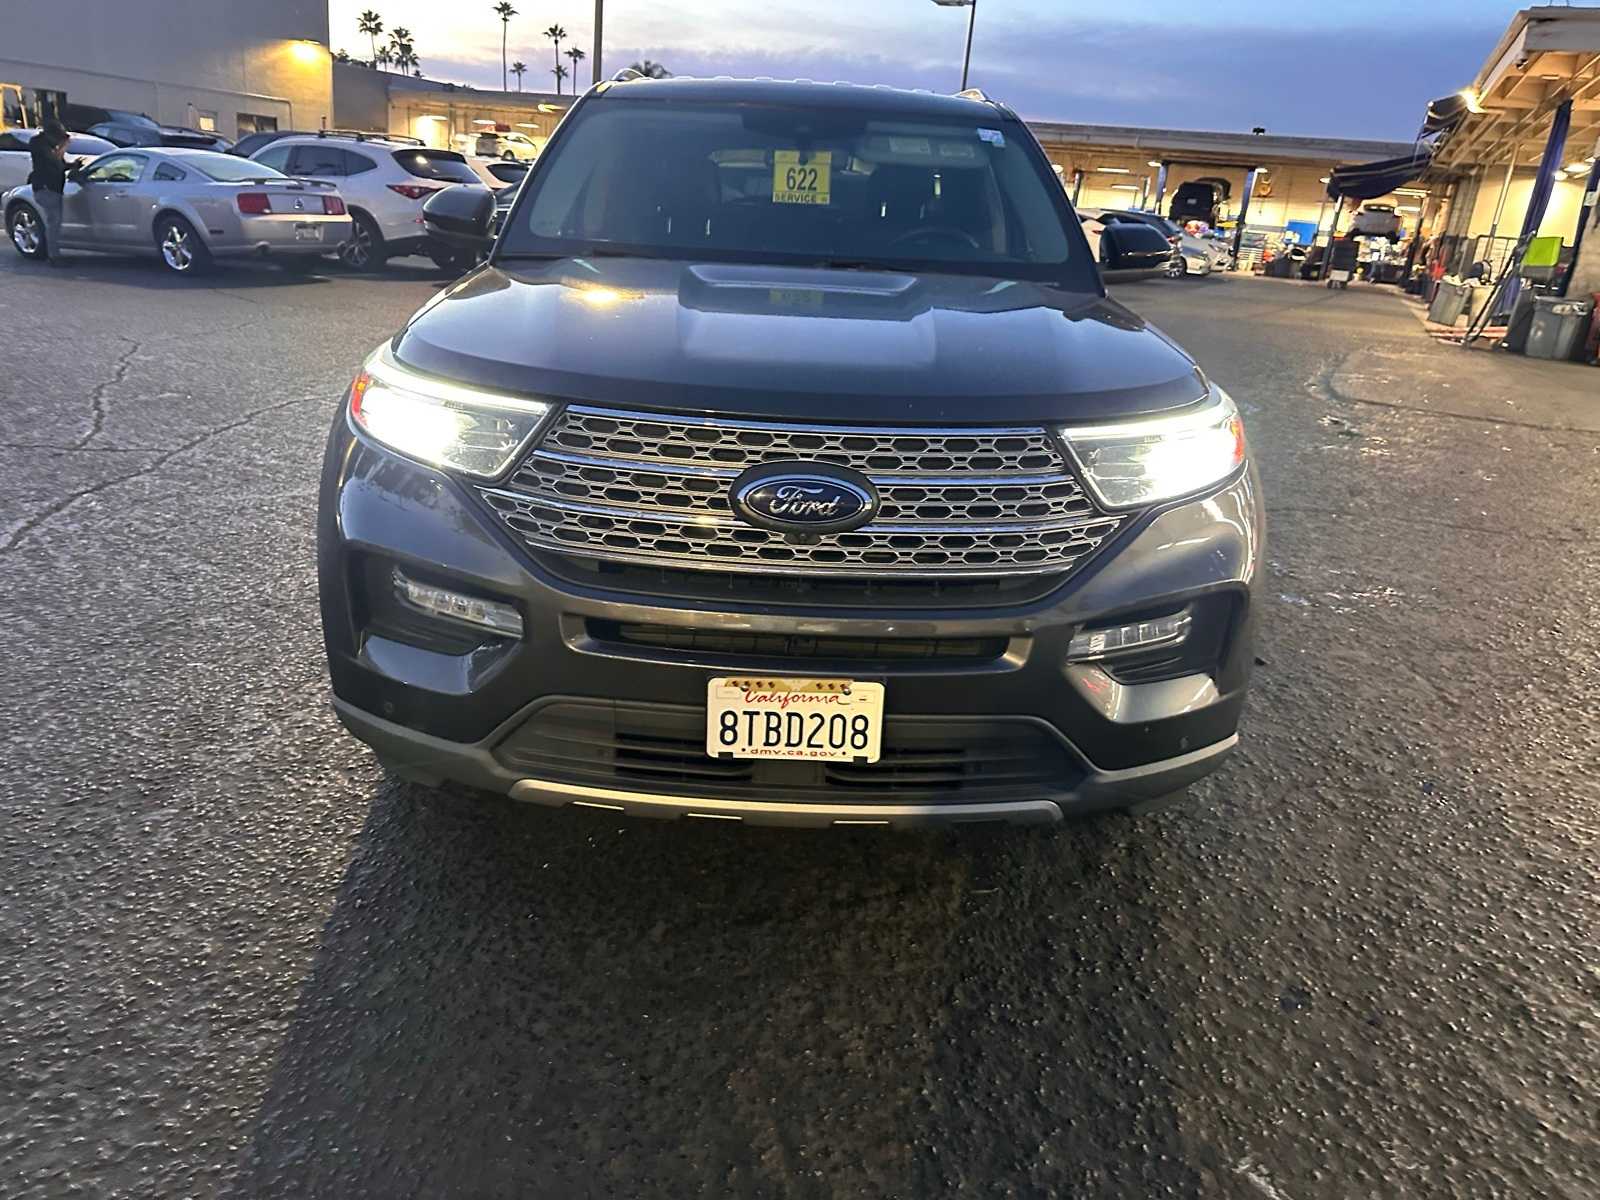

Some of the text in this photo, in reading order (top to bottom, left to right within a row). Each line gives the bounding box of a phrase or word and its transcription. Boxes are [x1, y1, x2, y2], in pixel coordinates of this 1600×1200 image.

[786, 167, 818, 191] 622
[774, 193, 817, 203] SERVICE
[769, 485, 840, 515] Ford
[744, 690, 850, 709] California
[719, 710, 869, 750] 8TBD208
